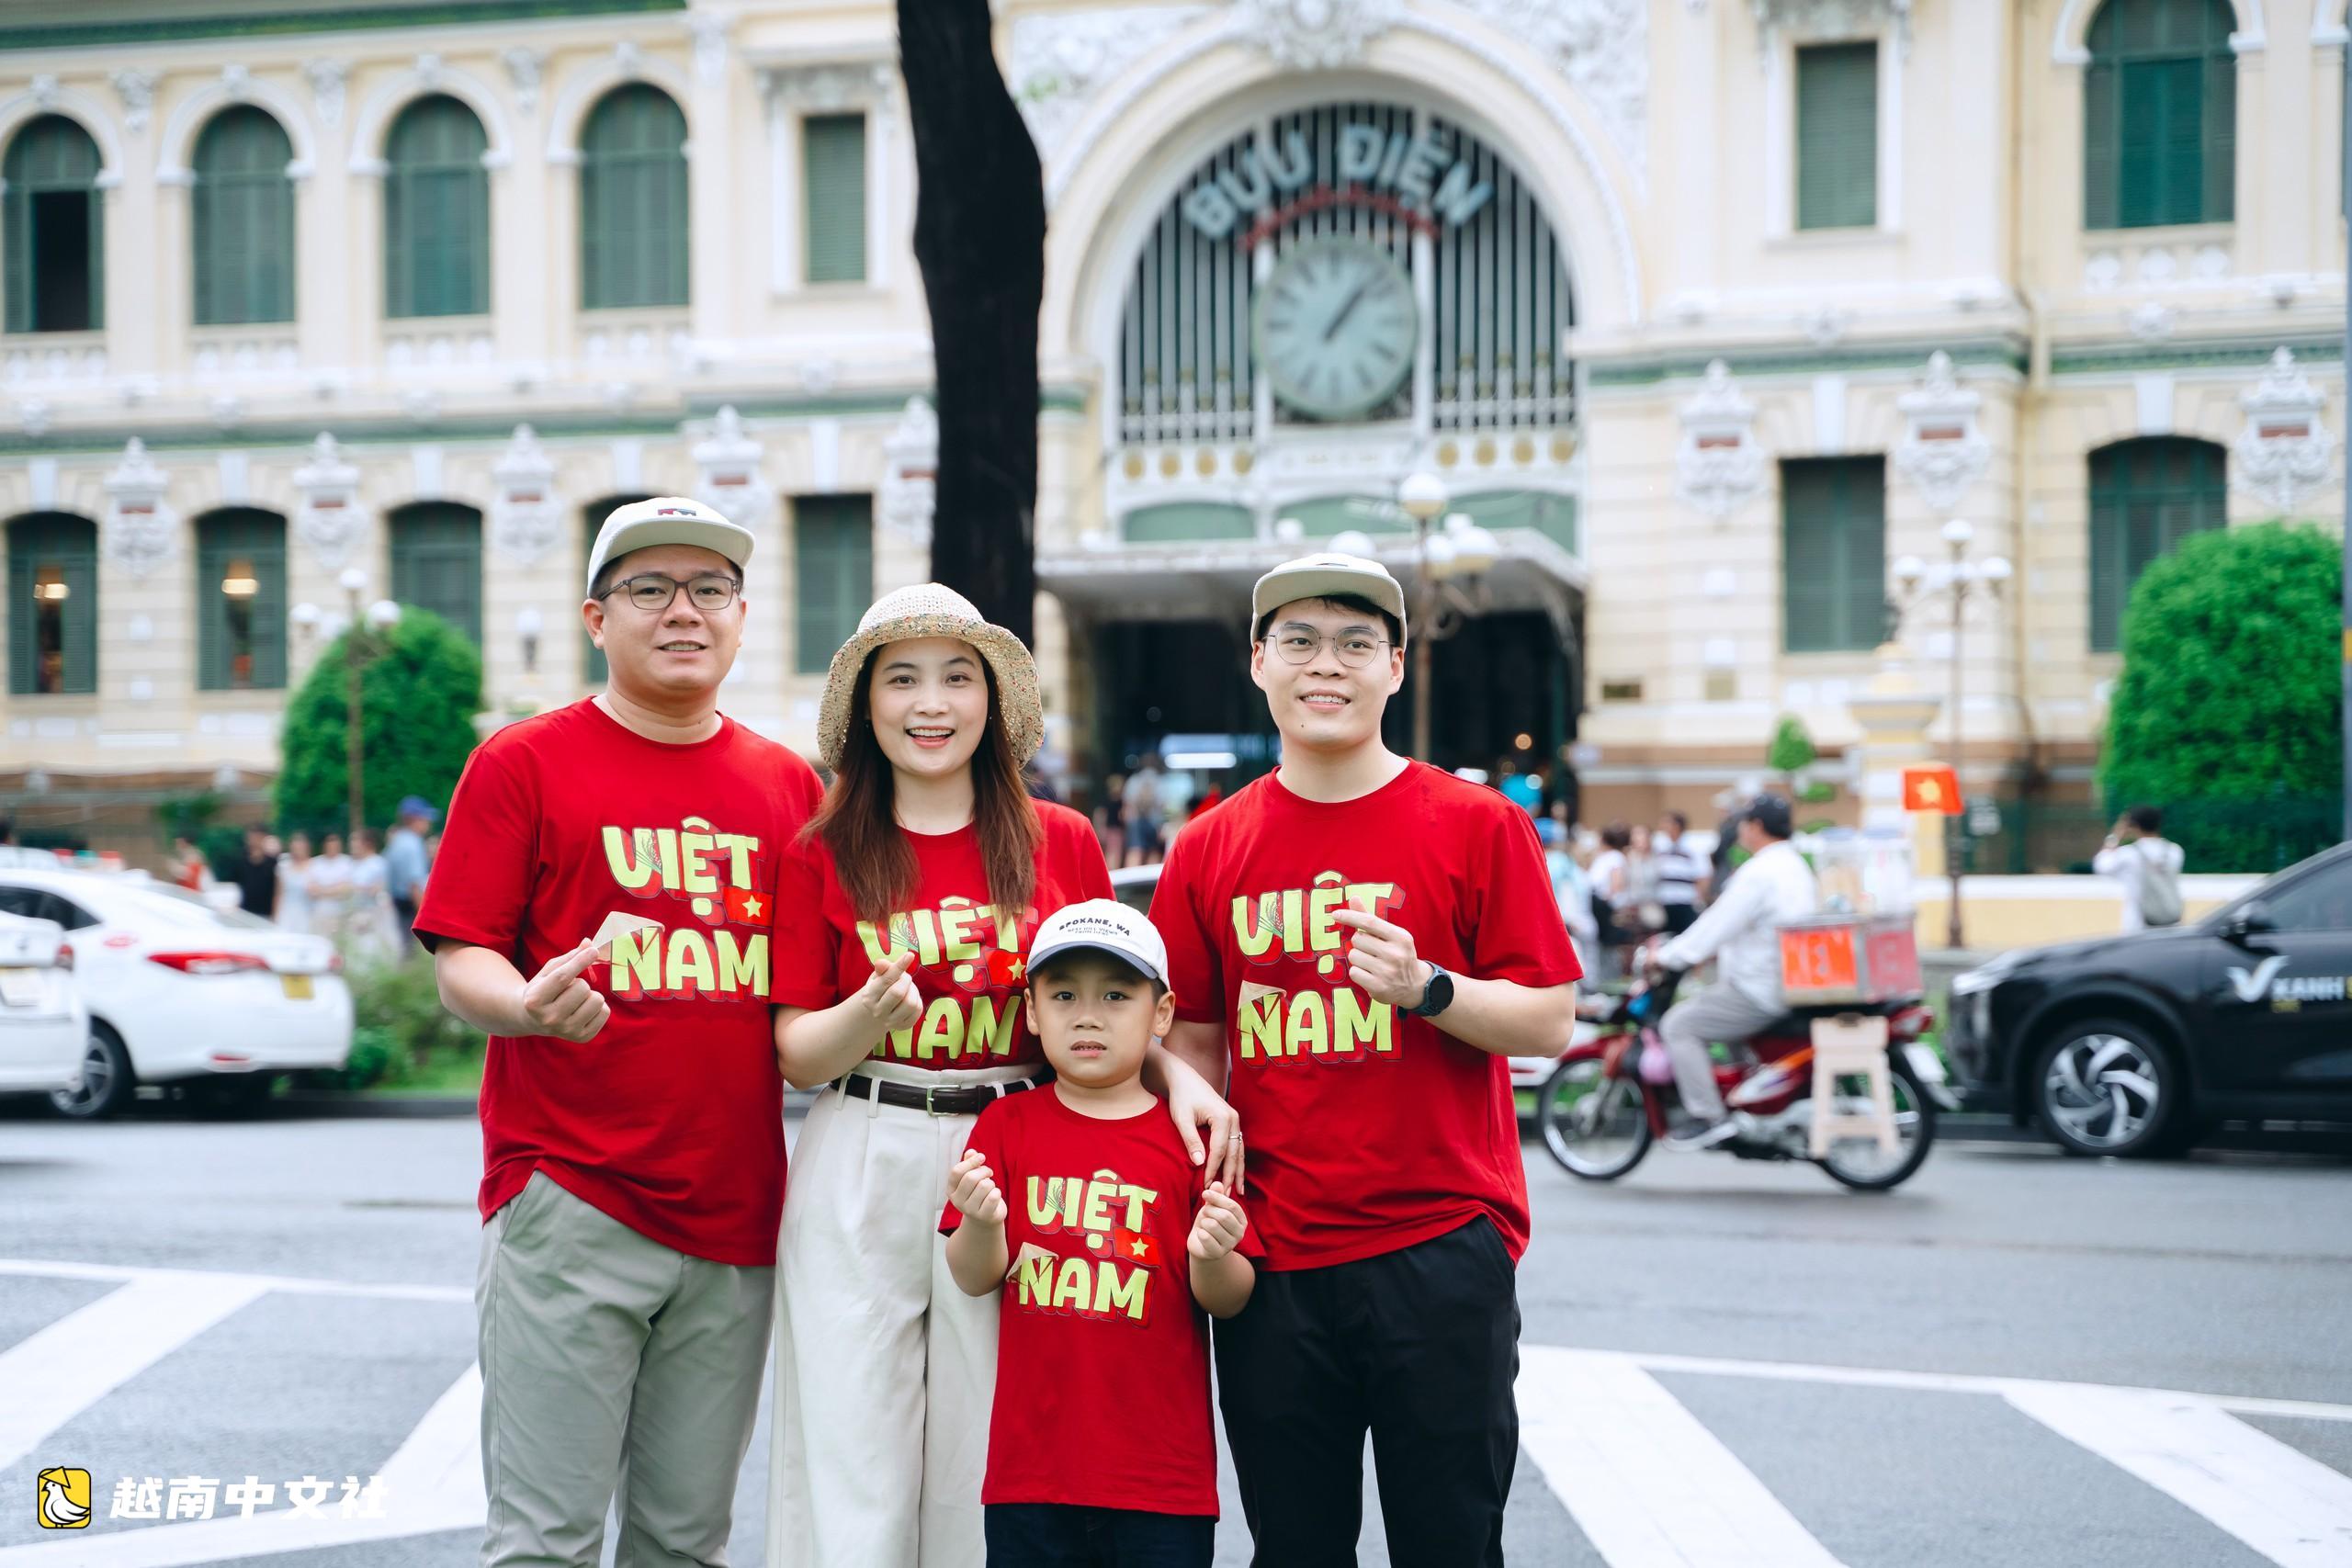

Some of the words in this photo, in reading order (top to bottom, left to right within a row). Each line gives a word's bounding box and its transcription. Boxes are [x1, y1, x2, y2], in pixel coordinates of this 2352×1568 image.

[602, 816, 759, 916] VIỆT
[611, 926, 770, 997] NAM
[1116, 923, 1130, 936] WA
[1240, 987, 1393, 1059] NAM
[1026, 1168, 1159, 1249] VIỆT
[1019, 1256, 1149, 1320] NAM
